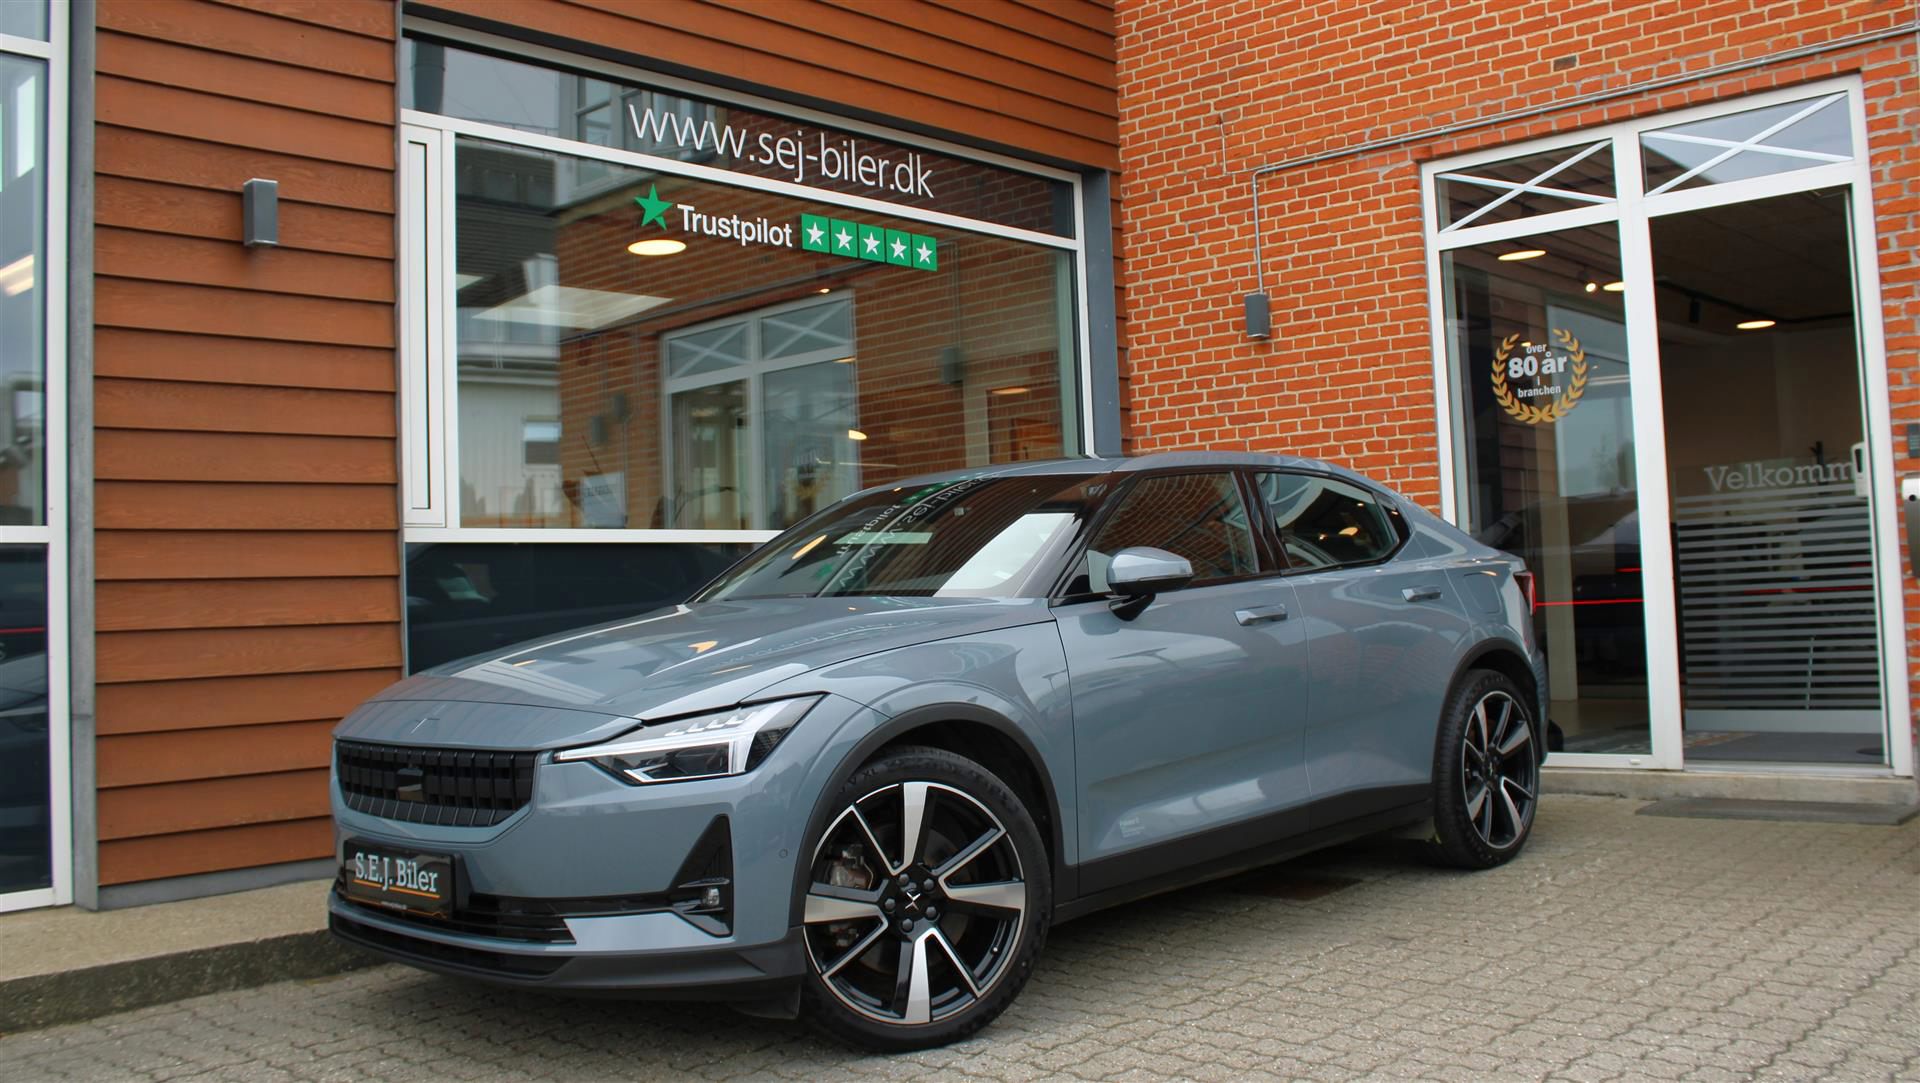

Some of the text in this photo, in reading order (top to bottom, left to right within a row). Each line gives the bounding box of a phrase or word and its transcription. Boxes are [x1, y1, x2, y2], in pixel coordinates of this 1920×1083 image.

[628, 103, 935, 198] www.sej-biler.dk
[676, 203, 793, 248] Trustpilot
[1508, 351, 1568, 378] 80 år
[1526, 343, 1547, 354] over
[1517, 386, 1561, 398] branchen
[355, 852, 439, 892] S.E.J. Biler
